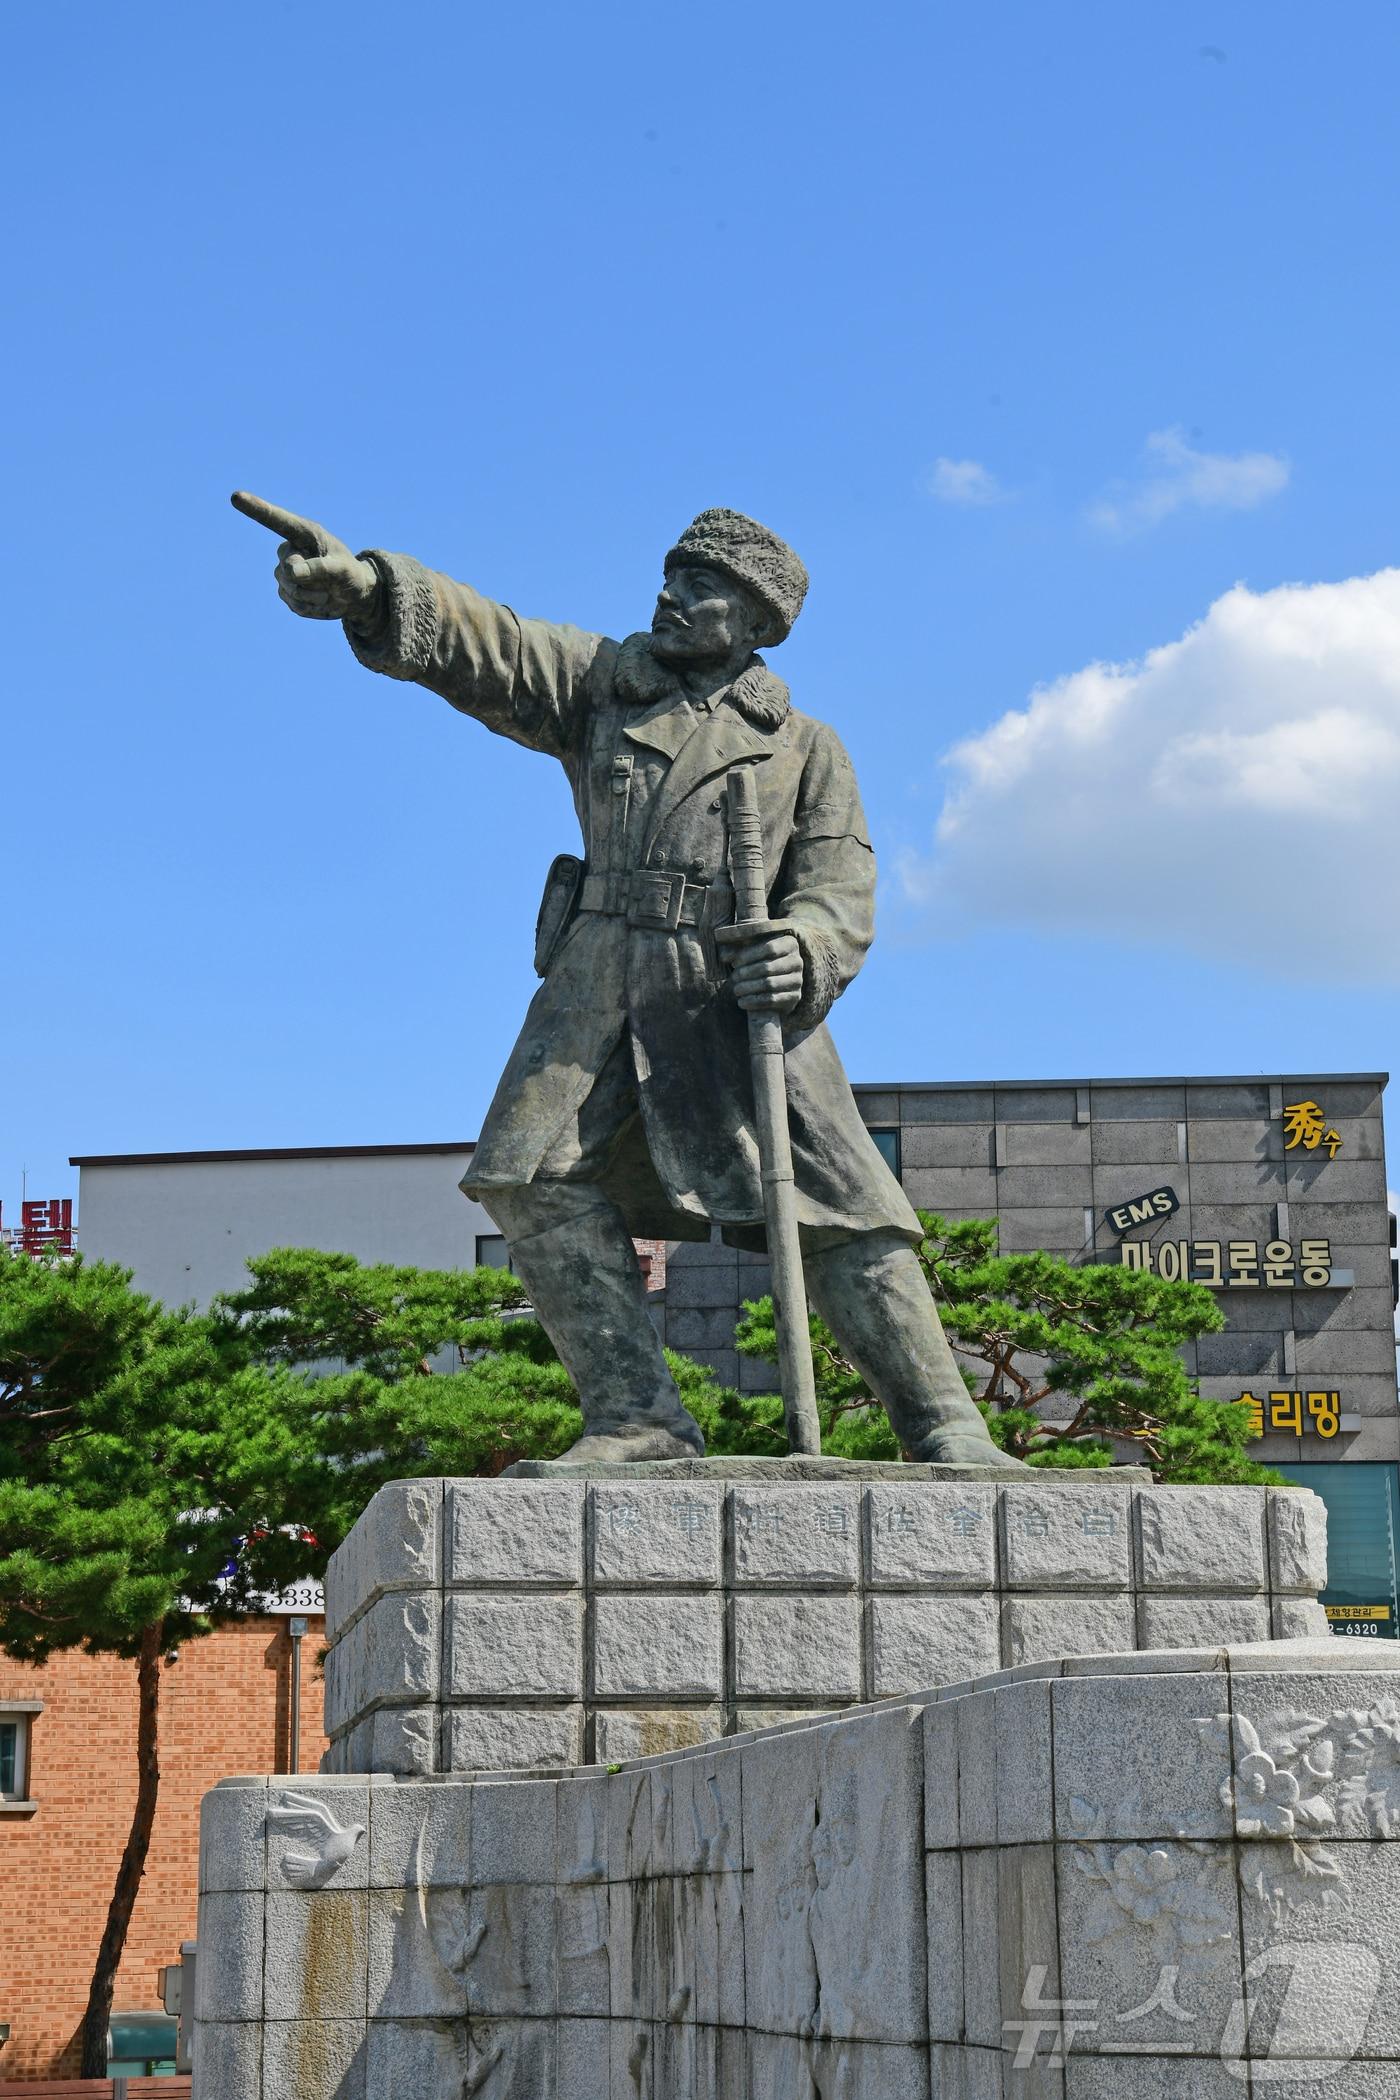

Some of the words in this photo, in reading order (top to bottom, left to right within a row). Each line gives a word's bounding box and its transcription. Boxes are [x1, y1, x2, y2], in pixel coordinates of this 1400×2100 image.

[0, 1199, 72, 1257] 텔
[1111, 1190, 1174, 1232] EMS
[1121, 1239, 1332, 1288] 마이크로운동
